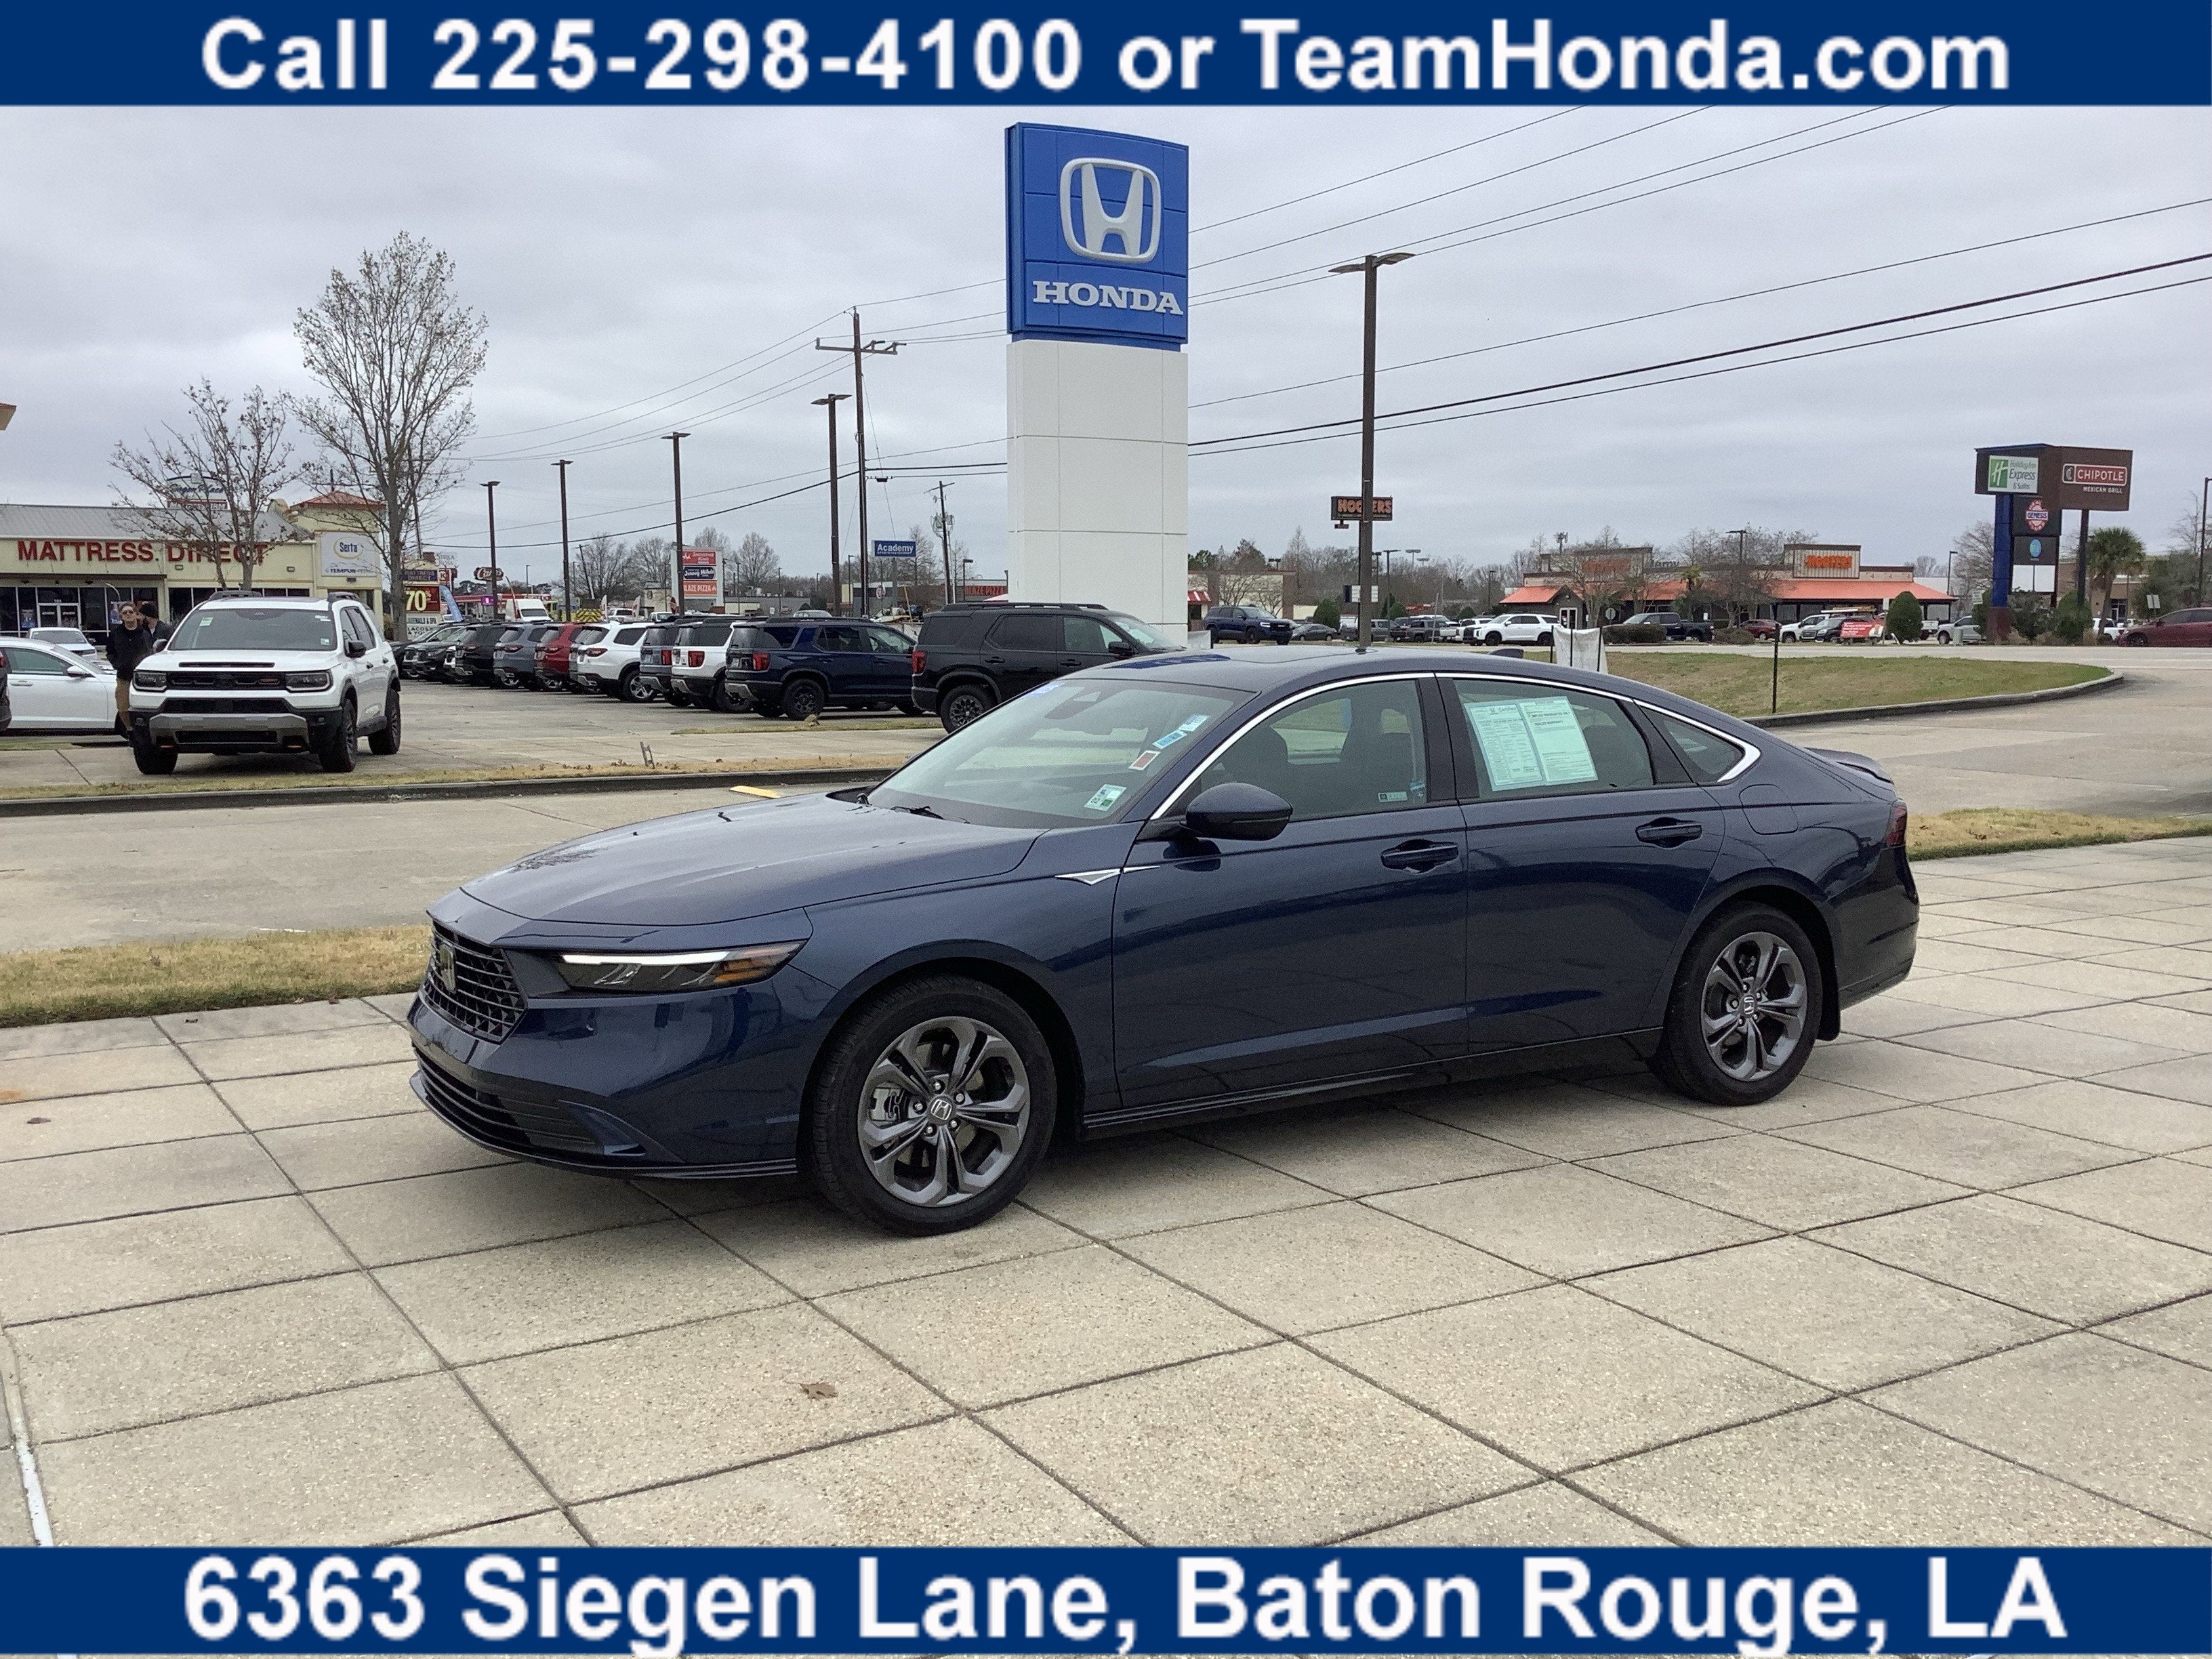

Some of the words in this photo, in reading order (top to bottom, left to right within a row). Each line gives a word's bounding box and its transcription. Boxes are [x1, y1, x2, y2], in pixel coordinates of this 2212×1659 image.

[1032, 280, 1184, 315] HONDA
[2009, 468, 2036, 481] Express
[2077, 469, 2125, 482] CHIPOTLE
[1337, 499, 1392, 514] HOOERS
[18, 540, 154, 562] MATTRESS
[340, 541, 358, 553] Serta
[877, 543, 914, 554] Academy
